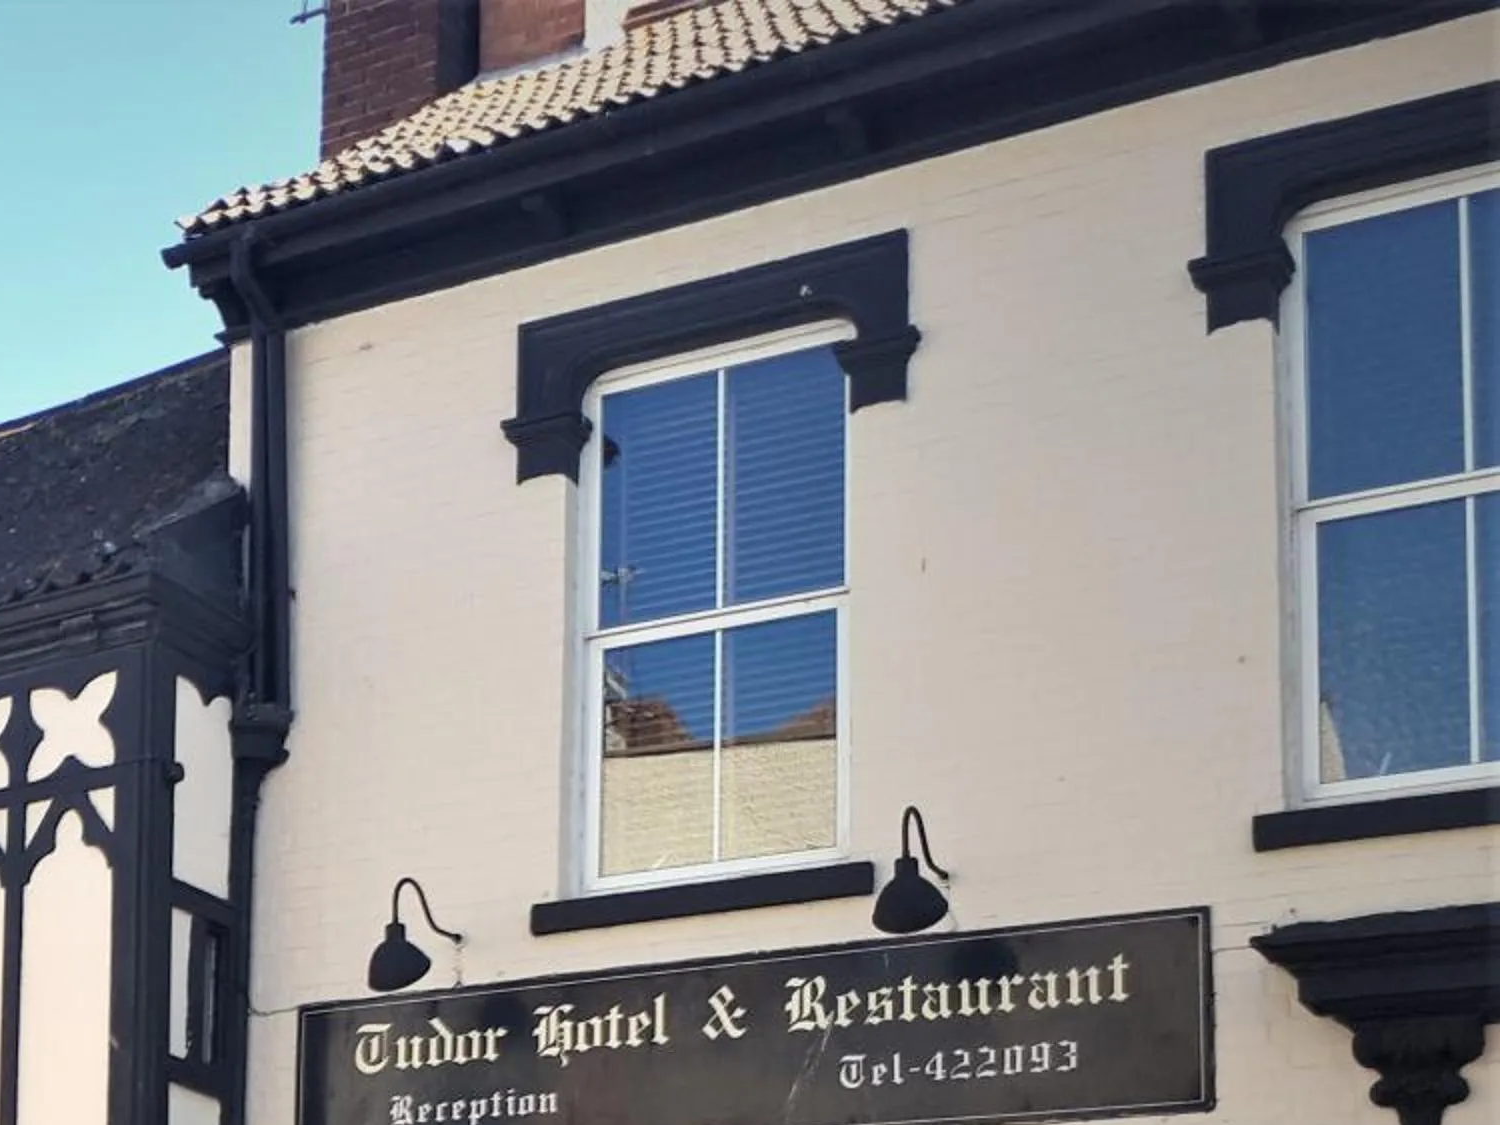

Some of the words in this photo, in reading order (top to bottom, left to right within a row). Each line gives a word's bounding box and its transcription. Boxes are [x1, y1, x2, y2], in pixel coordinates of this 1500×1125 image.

[354, 1017, 508, 1075] Tudor
[532, 992, 670, 1067] Hotel
[702, 985, 747, 1041] &
[784, 953, 1130, 1033] Restaurant
[836, 1039, 1079, 1089] Tel-422093
